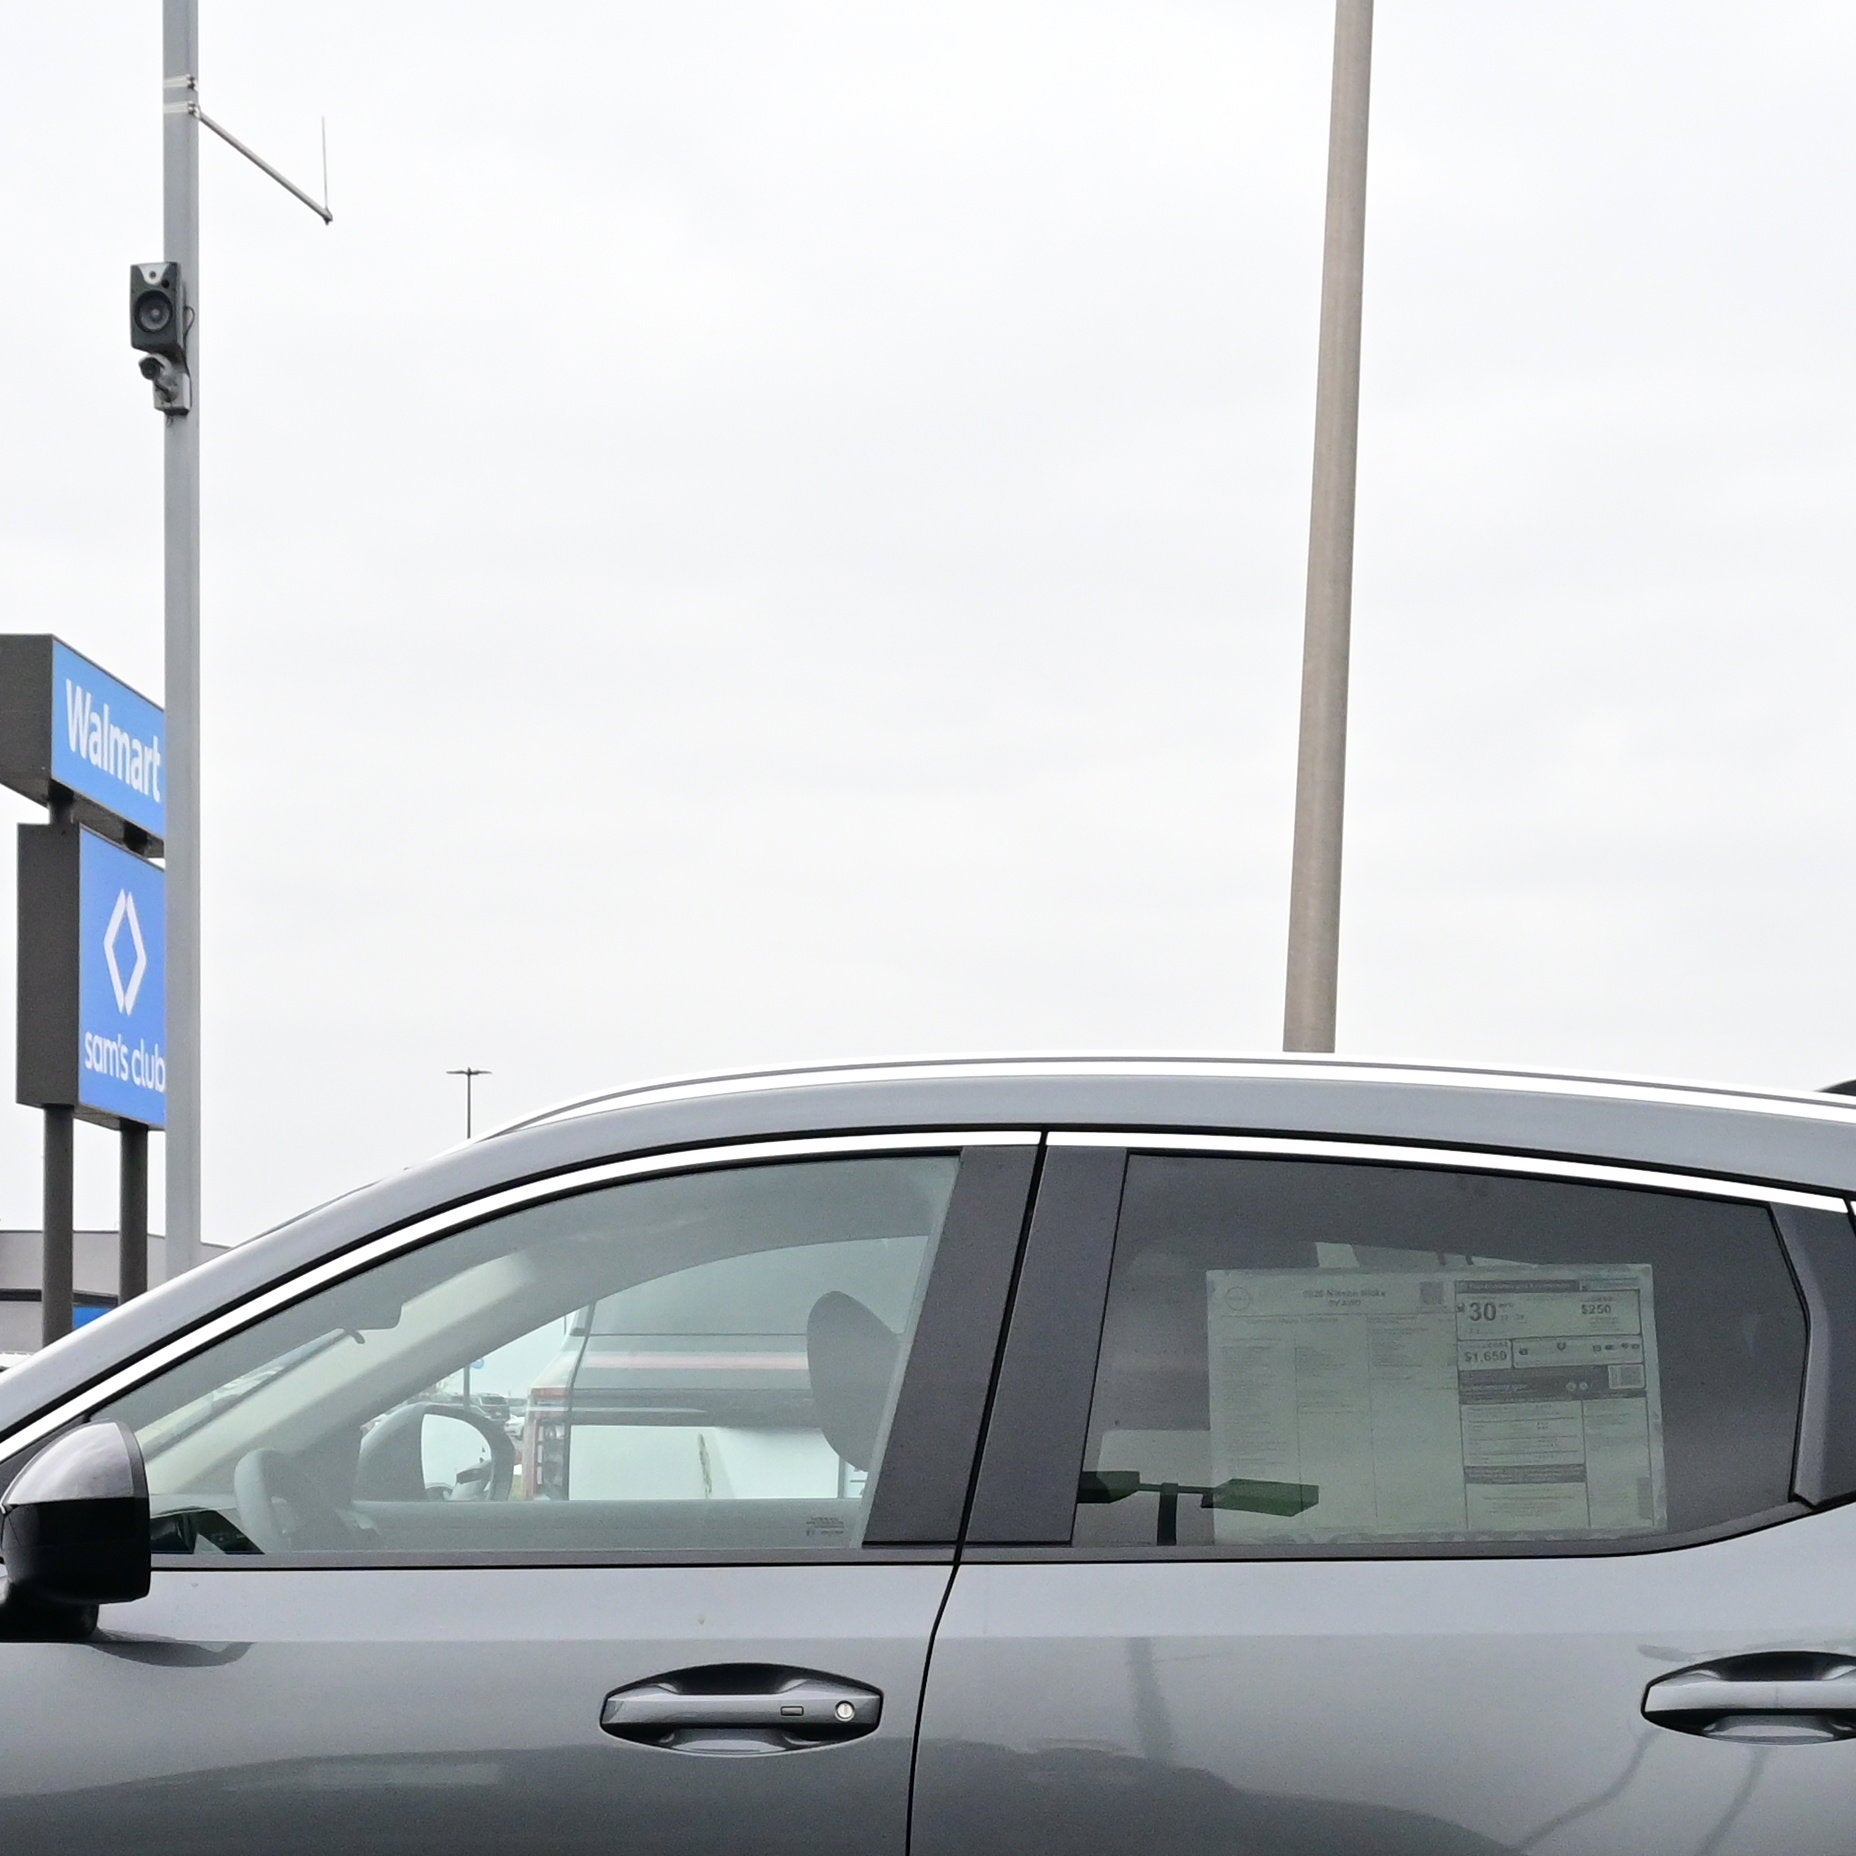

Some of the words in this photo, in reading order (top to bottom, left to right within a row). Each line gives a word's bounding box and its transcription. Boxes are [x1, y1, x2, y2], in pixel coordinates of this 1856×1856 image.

[65, 678, 161, 803] Walmart
[84, 1031, 129, 1082] sam's
[131, 1037, 166, 1093] club
[1468, 1302, 1497, 1322] 30
[1581, 1304, 1612, 1315] $250
[1464, 1350, 1508, 1364] $1,650
